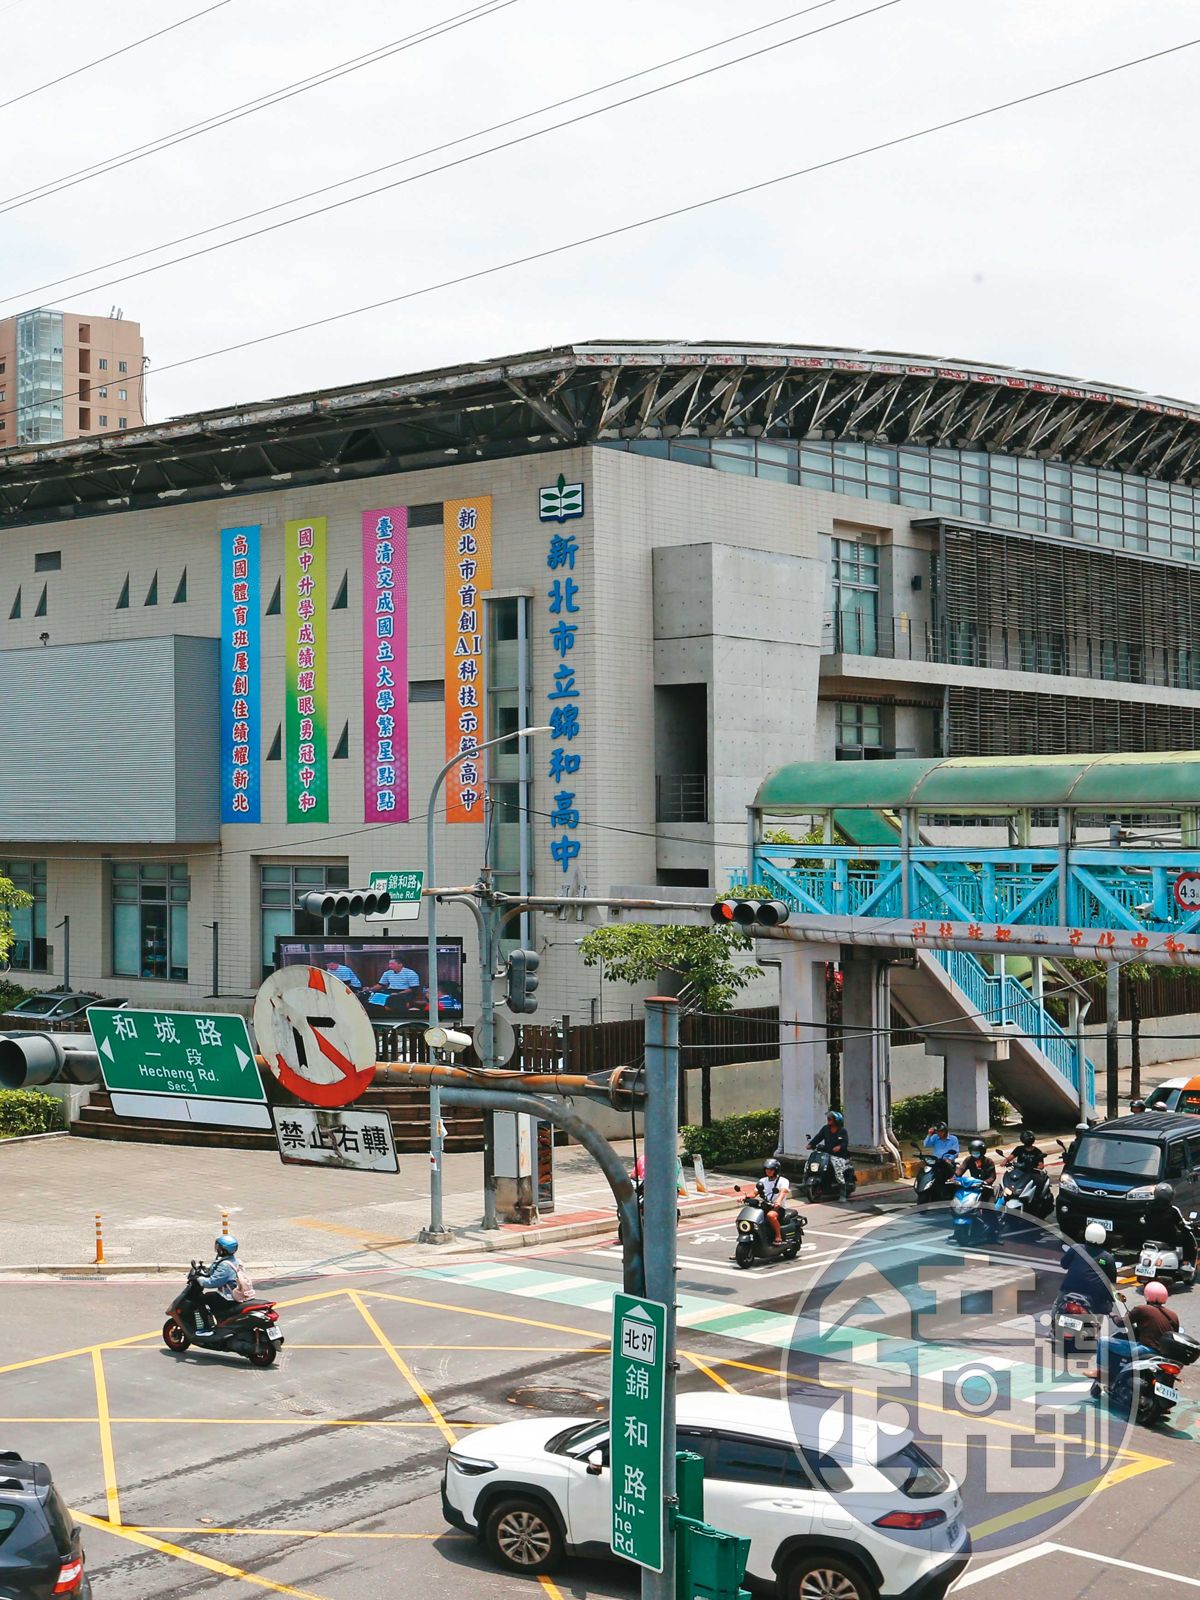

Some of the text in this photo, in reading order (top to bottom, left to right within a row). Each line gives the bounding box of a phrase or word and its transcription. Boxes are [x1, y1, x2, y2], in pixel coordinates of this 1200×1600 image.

[298, 528, 315, 812] 國中升學成績耀眼勇冠中和
[375, 517, 395, 811] 臺清交成國立大學繁星點點
[455, 509, 482, 812] 新北市首創AI科技示範高中
[232, 535, 249, 812] 高國體育班屢創佳績耀新北
[547, 534, 581, 873] 新北市立錦和高中
[388, 875, 416, 890] 錦和路
[1180, 885, 1195, 898] 4.3
[405, 891, 415, 899] Rd.
[112, 1014, 222, 1047] 和城路
[145, 1048, 204, 1066] 一段
[138, 1064, 219, 1083] Hecheng Rd.
[167, 1080, 198, 1092] Sec. 1
[280, 1120, 390, 1156] 禁止右轉
[625, 1329, 653, 1352] 北97
[624, 1364, 648, 1501] 錦和路
[615, 1495, 645, 1517] Jin-
[615, 1513, 632, 1534] he
[615, 1531, 638, 1556] Rd.
